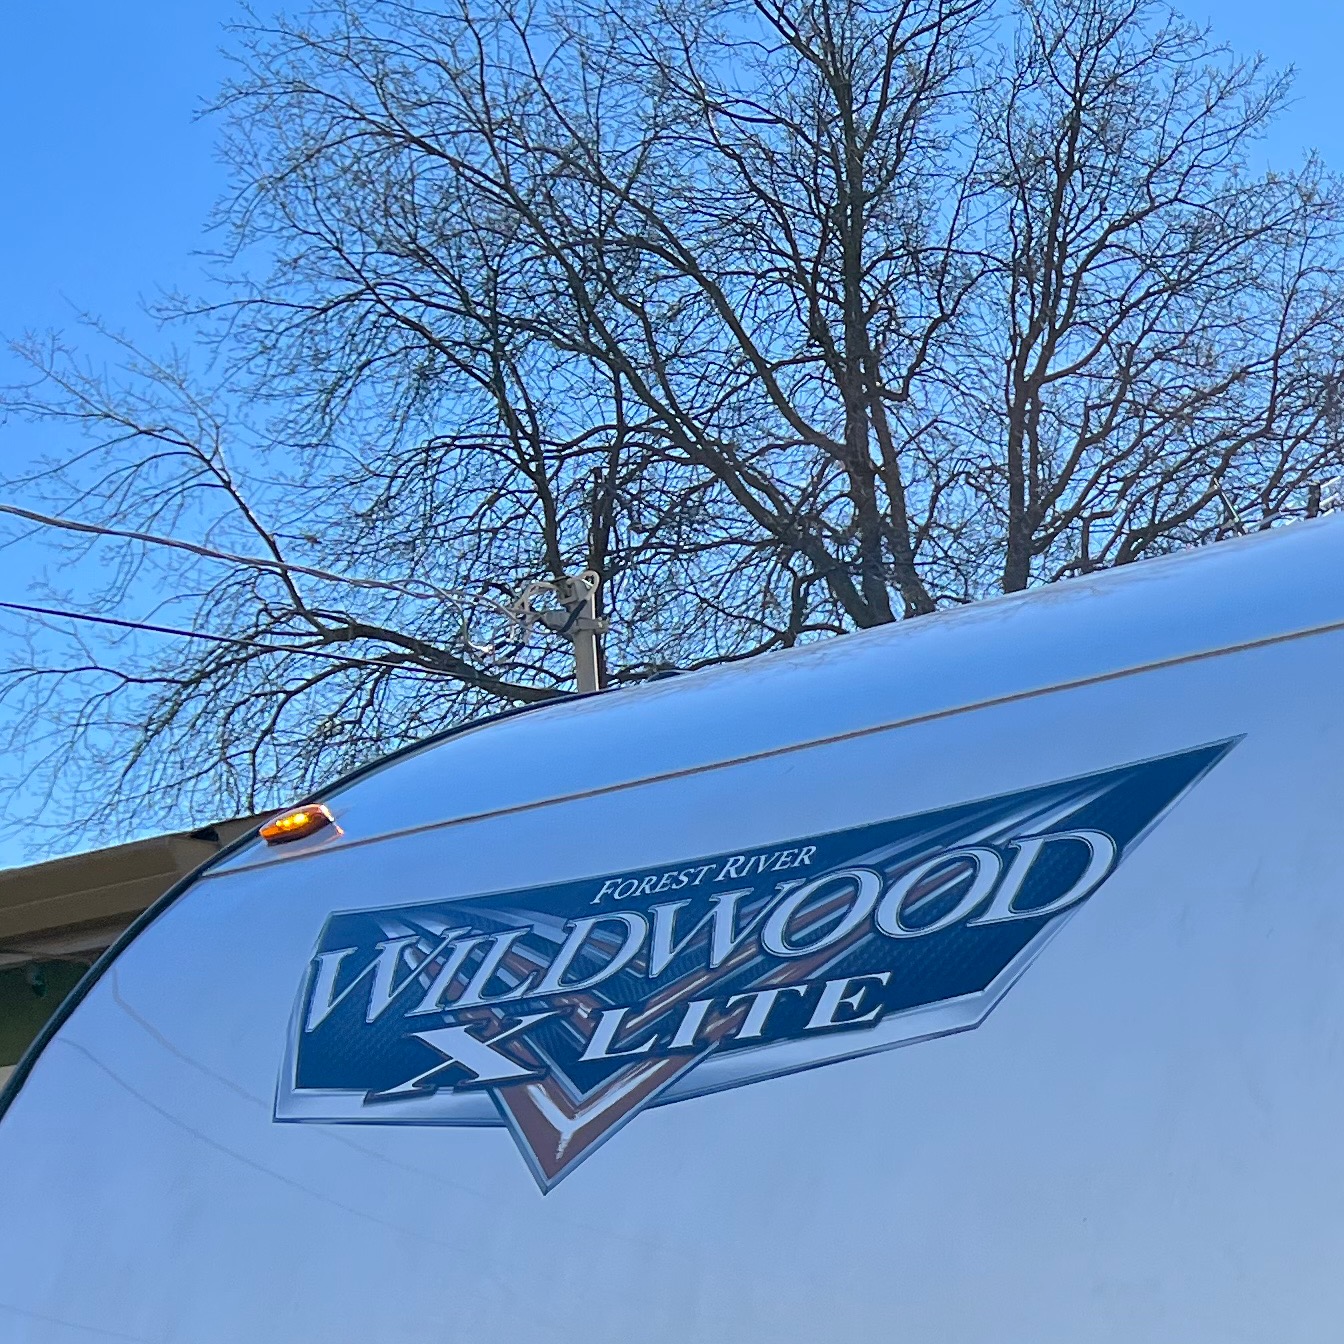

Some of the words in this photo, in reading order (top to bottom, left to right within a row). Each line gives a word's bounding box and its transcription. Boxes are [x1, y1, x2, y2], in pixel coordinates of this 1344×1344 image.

[590, 863, 717, 905] FOREST
[716, 844, 817, 884] RIVER
[304, 828, 1118, 1033] WILDWOOD
[578, 970, 893, 1063] LITE
